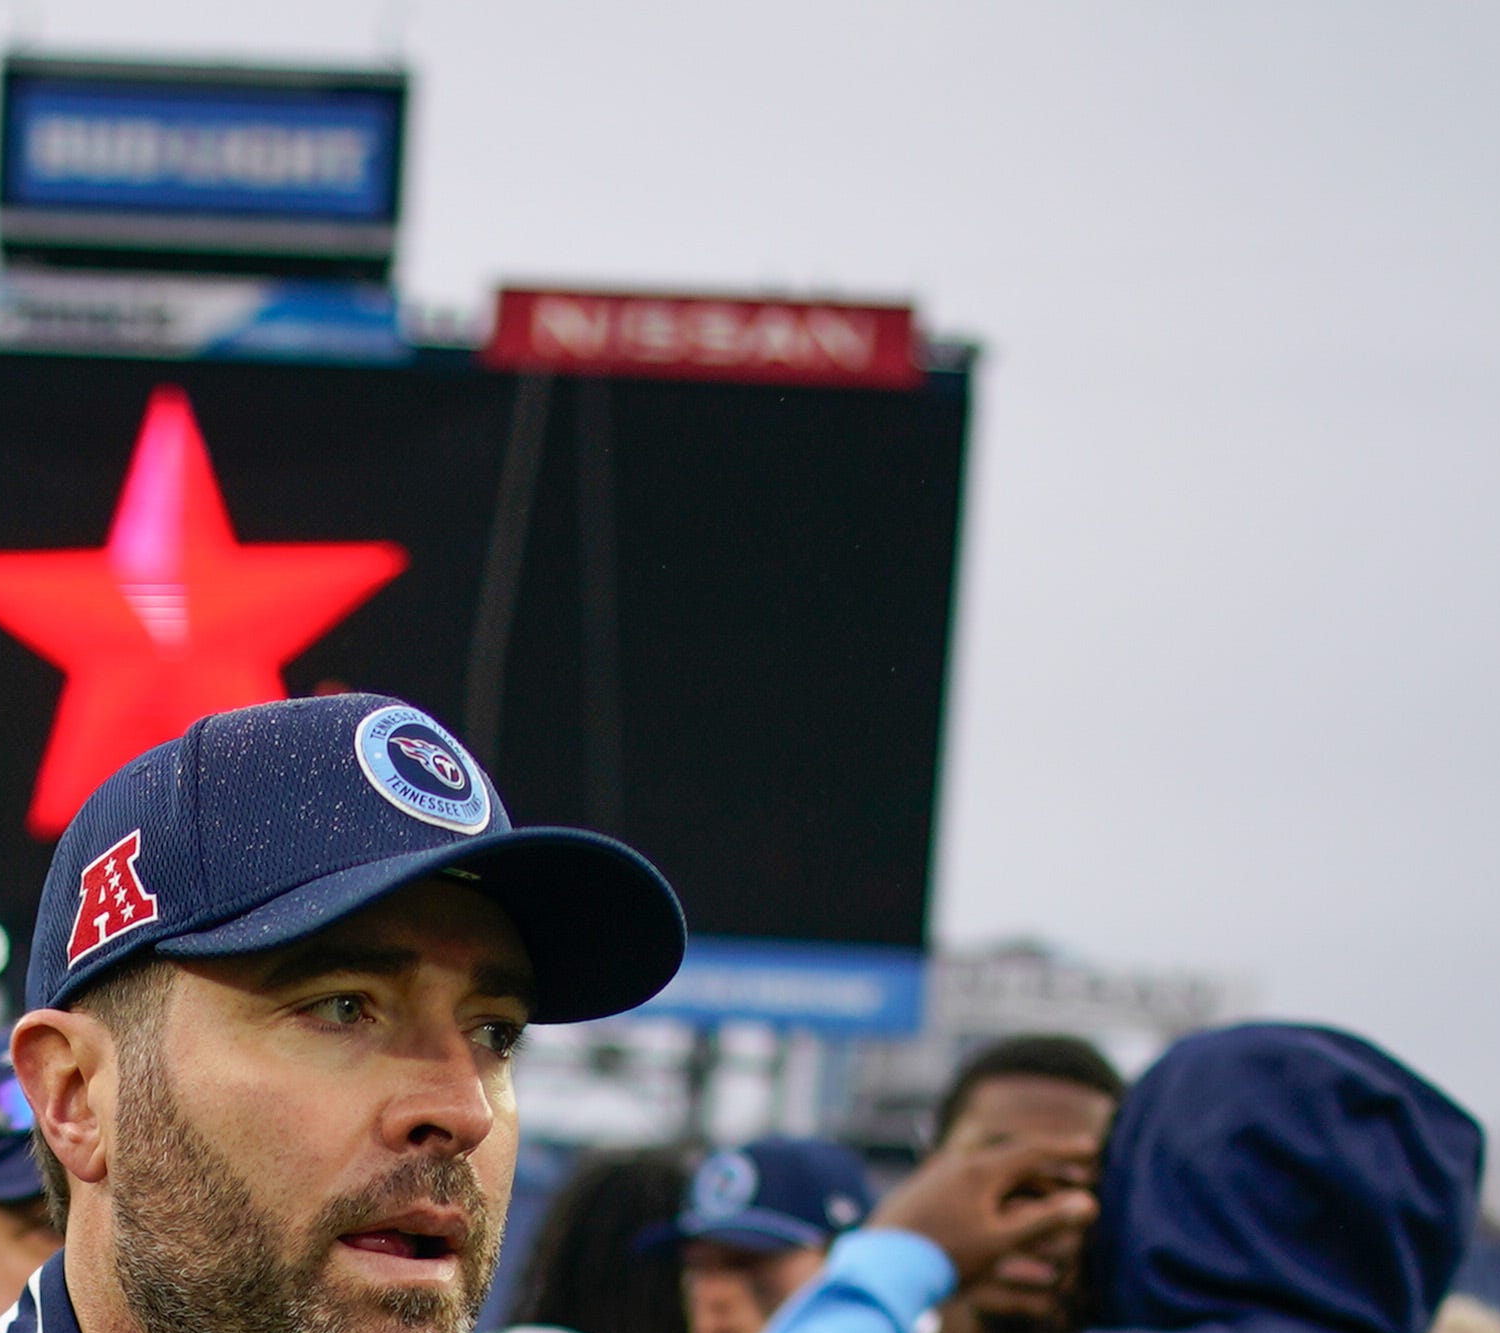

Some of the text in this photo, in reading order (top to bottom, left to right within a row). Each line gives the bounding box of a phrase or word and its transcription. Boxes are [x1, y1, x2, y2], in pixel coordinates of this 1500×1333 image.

[532, 297, 874, 372] NISSAN
[369, 711, 430, 742] TENNESSEE
[385, 774, 461, 817] TENNESSEE
